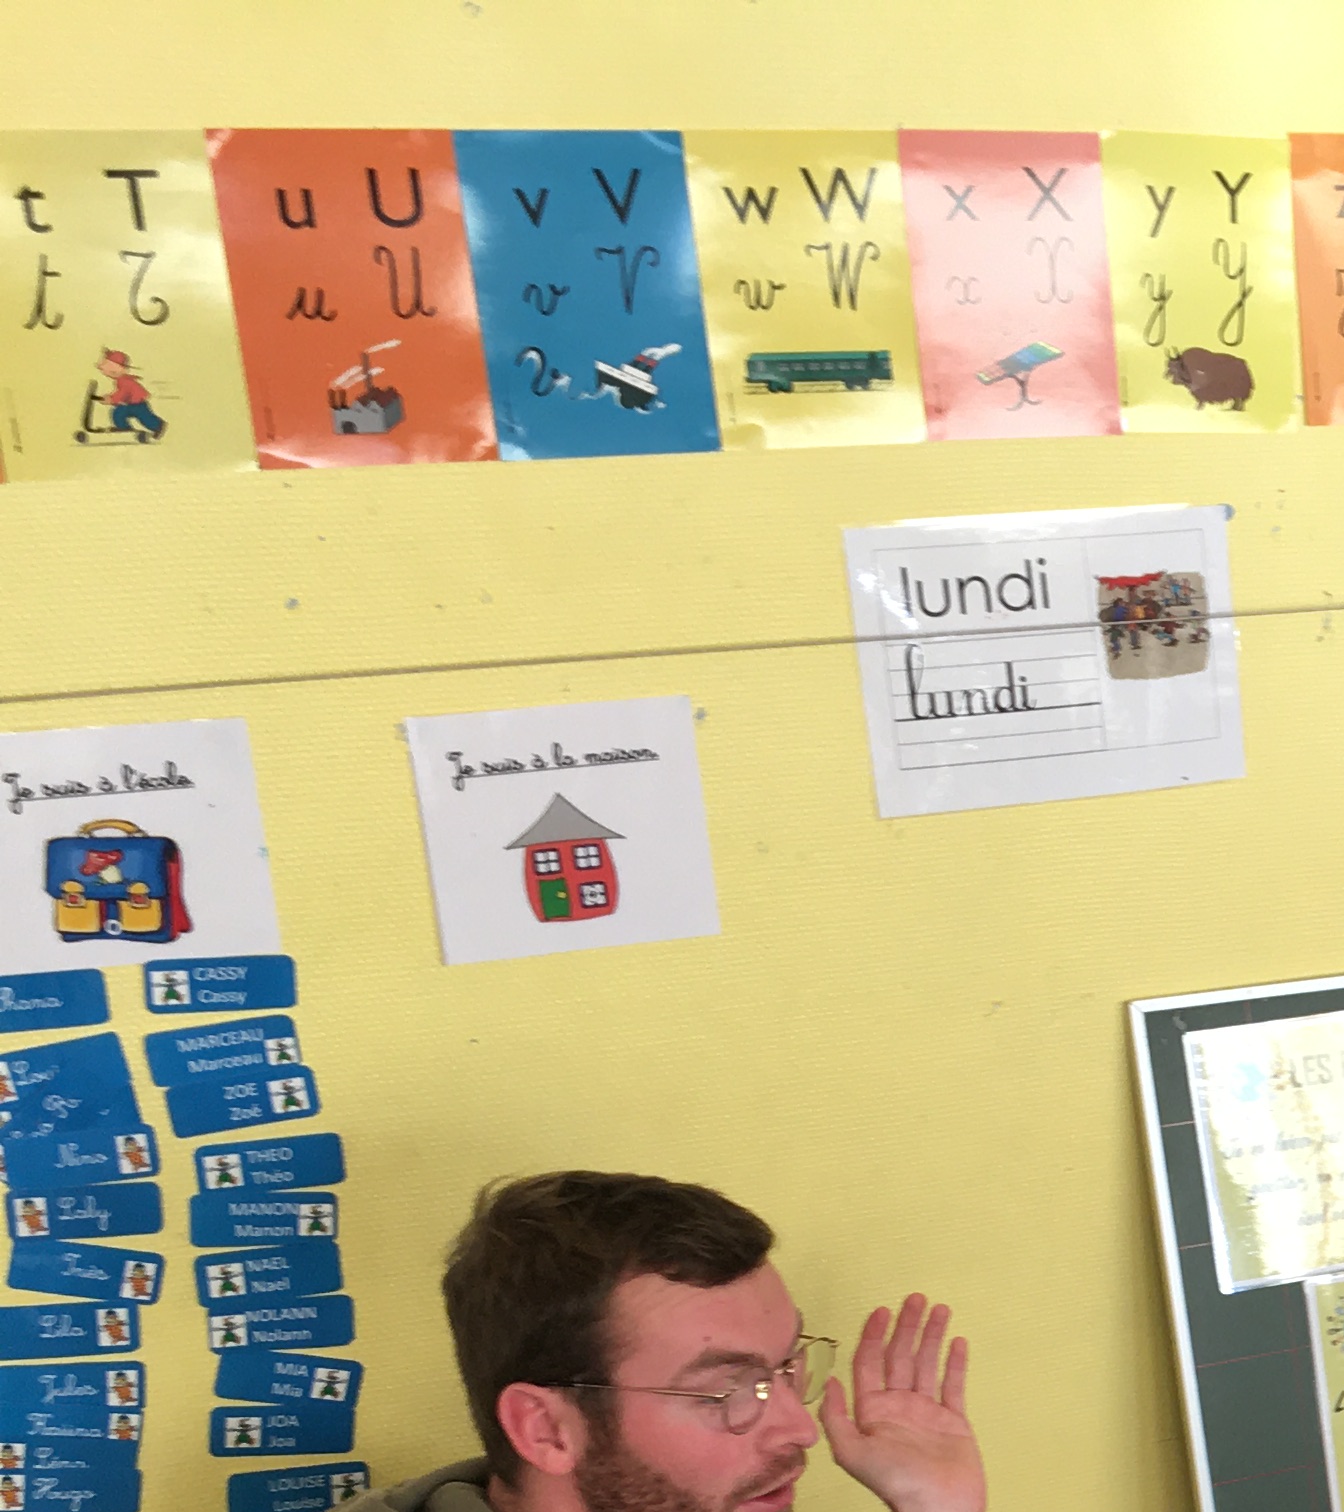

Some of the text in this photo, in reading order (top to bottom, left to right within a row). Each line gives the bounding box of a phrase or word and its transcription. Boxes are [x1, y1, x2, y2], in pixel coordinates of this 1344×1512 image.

[15, 169, 158, 233] t T
[275, 167, 422, 229] u U
[512, 168, 642, 228] v V
[723, 167, 878, 223] w W
[942, 167, 1073, 221] x X
[1145, 170, 1253, 237] y Y
[22, 253, 63, 329] t
[286, 246, 437, 322] u U
[594, 246, 661, 314] V
[734, 242, 880, 310] w W
[1026, 236, 1075, 304] X
[1140, 237, 1254, 346] y Y
[899, 557, 1050, 618] lundi
[907, 642, 1037, 720] lundi
[1, 772, 35, 815] Je
[446, 751, 476, 791] Je
[551, 742, 579, 767] la
[582, 747, 660, 764] maison
[192, 966, 248, 981] CASSY
[197, 988, 248, 1005] Cassy
[175, 1028, 265, 1053] MARCEAU
[188, 1053, 264, 1073] Marceau
[222, 1083, 259, 1100] ZOE
[1289, 1054, 1333, 1088] LES
[228, 1202, 299, 1218] MANON
[233, 1224, 294, 1238] Manon
[267, 1474, 326, 1492] LOUISE
